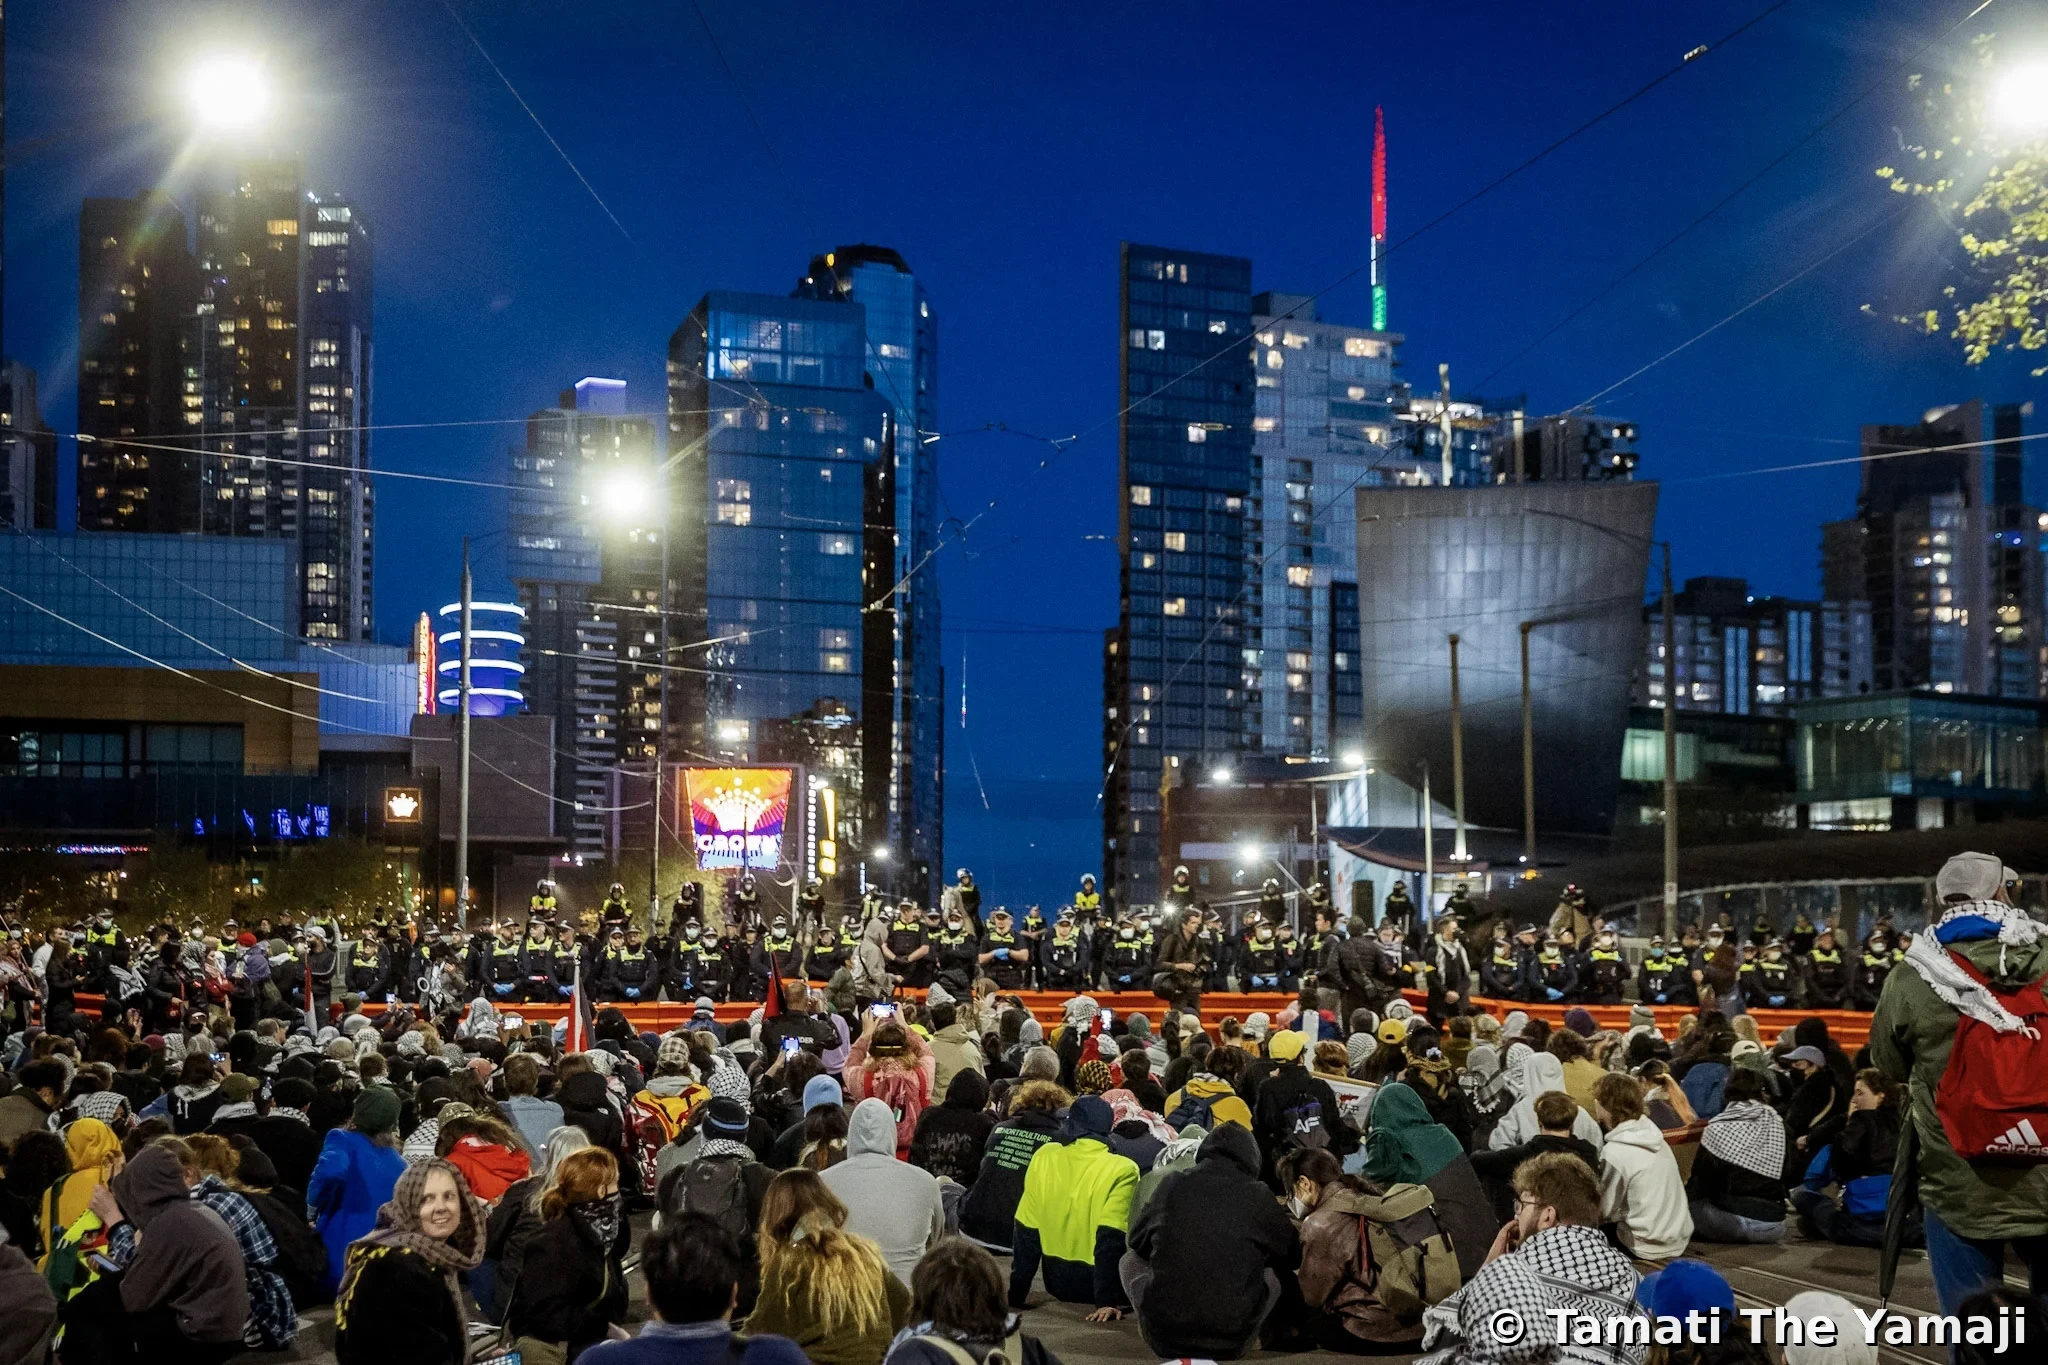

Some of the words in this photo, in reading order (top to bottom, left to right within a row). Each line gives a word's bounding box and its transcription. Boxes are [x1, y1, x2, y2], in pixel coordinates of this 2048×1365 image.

[780, 1034, 815, 1044] TDER
[1003, 1127, 1052, 1143] HORTICULTURE
[1004, 1135, 1034, 1146] LANDSCAPING
[924, 1131, 972, 1152] LWAYS
[1985, 1143, 2048, 1156] adidas
[997, 1159, 1020, 1170] FLORISTRY
